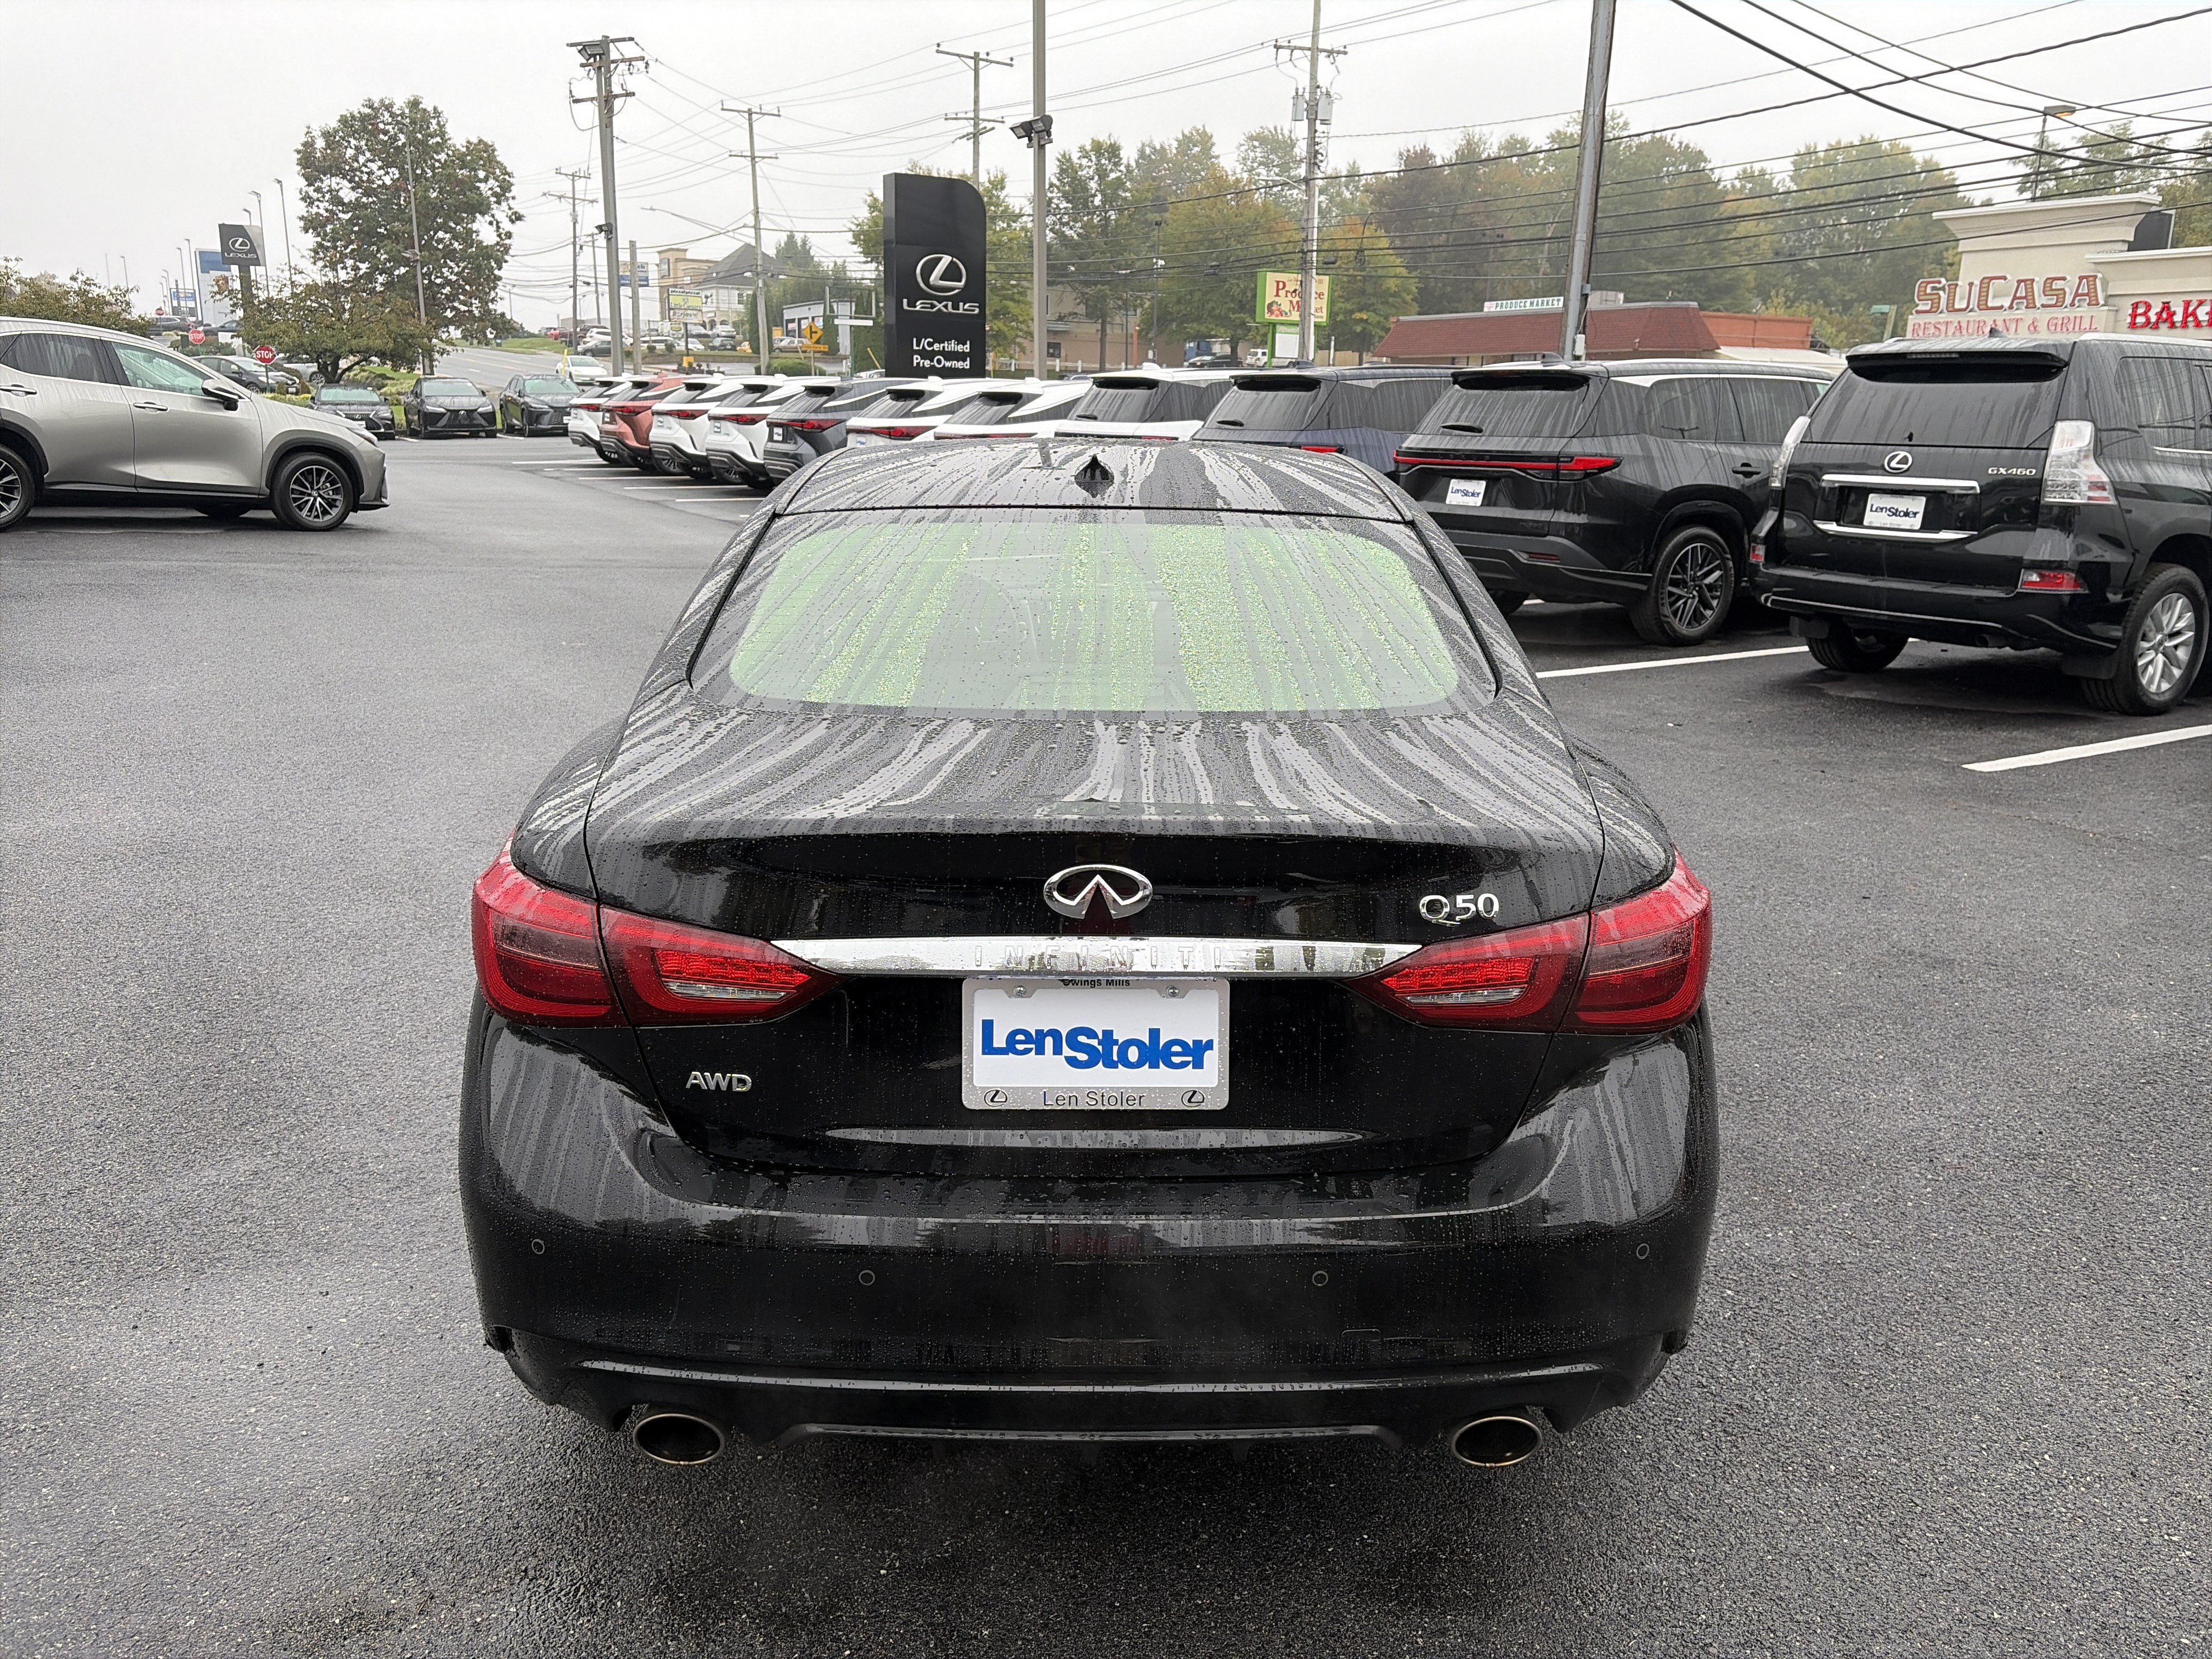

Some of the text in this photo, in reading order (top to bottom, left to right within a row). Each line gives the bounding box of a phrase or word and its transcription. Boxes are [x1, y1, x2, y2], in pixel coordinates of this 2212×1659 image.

[902, 298, 980, 314] LEXUS
[1495, 301, 1527, 309] PRODUCE
[1529, 298, 1561, 307] MARKET
[2128, 299, 2212, 329] BAK
[2028, 317, 2039, 333] &
[2047, 315, 2098, 332] GRILL
[913, 337, 970, 352] L/Certified
[913, 355, 970, 369] Pre-Owned
[1419, 893, 1499, 927] Q50
[974, 945, 1222, 971] INFINITI
[686, 1071, 752, 1092] AWD
[1043, 1091, 1146, 1107] Len Stoler
